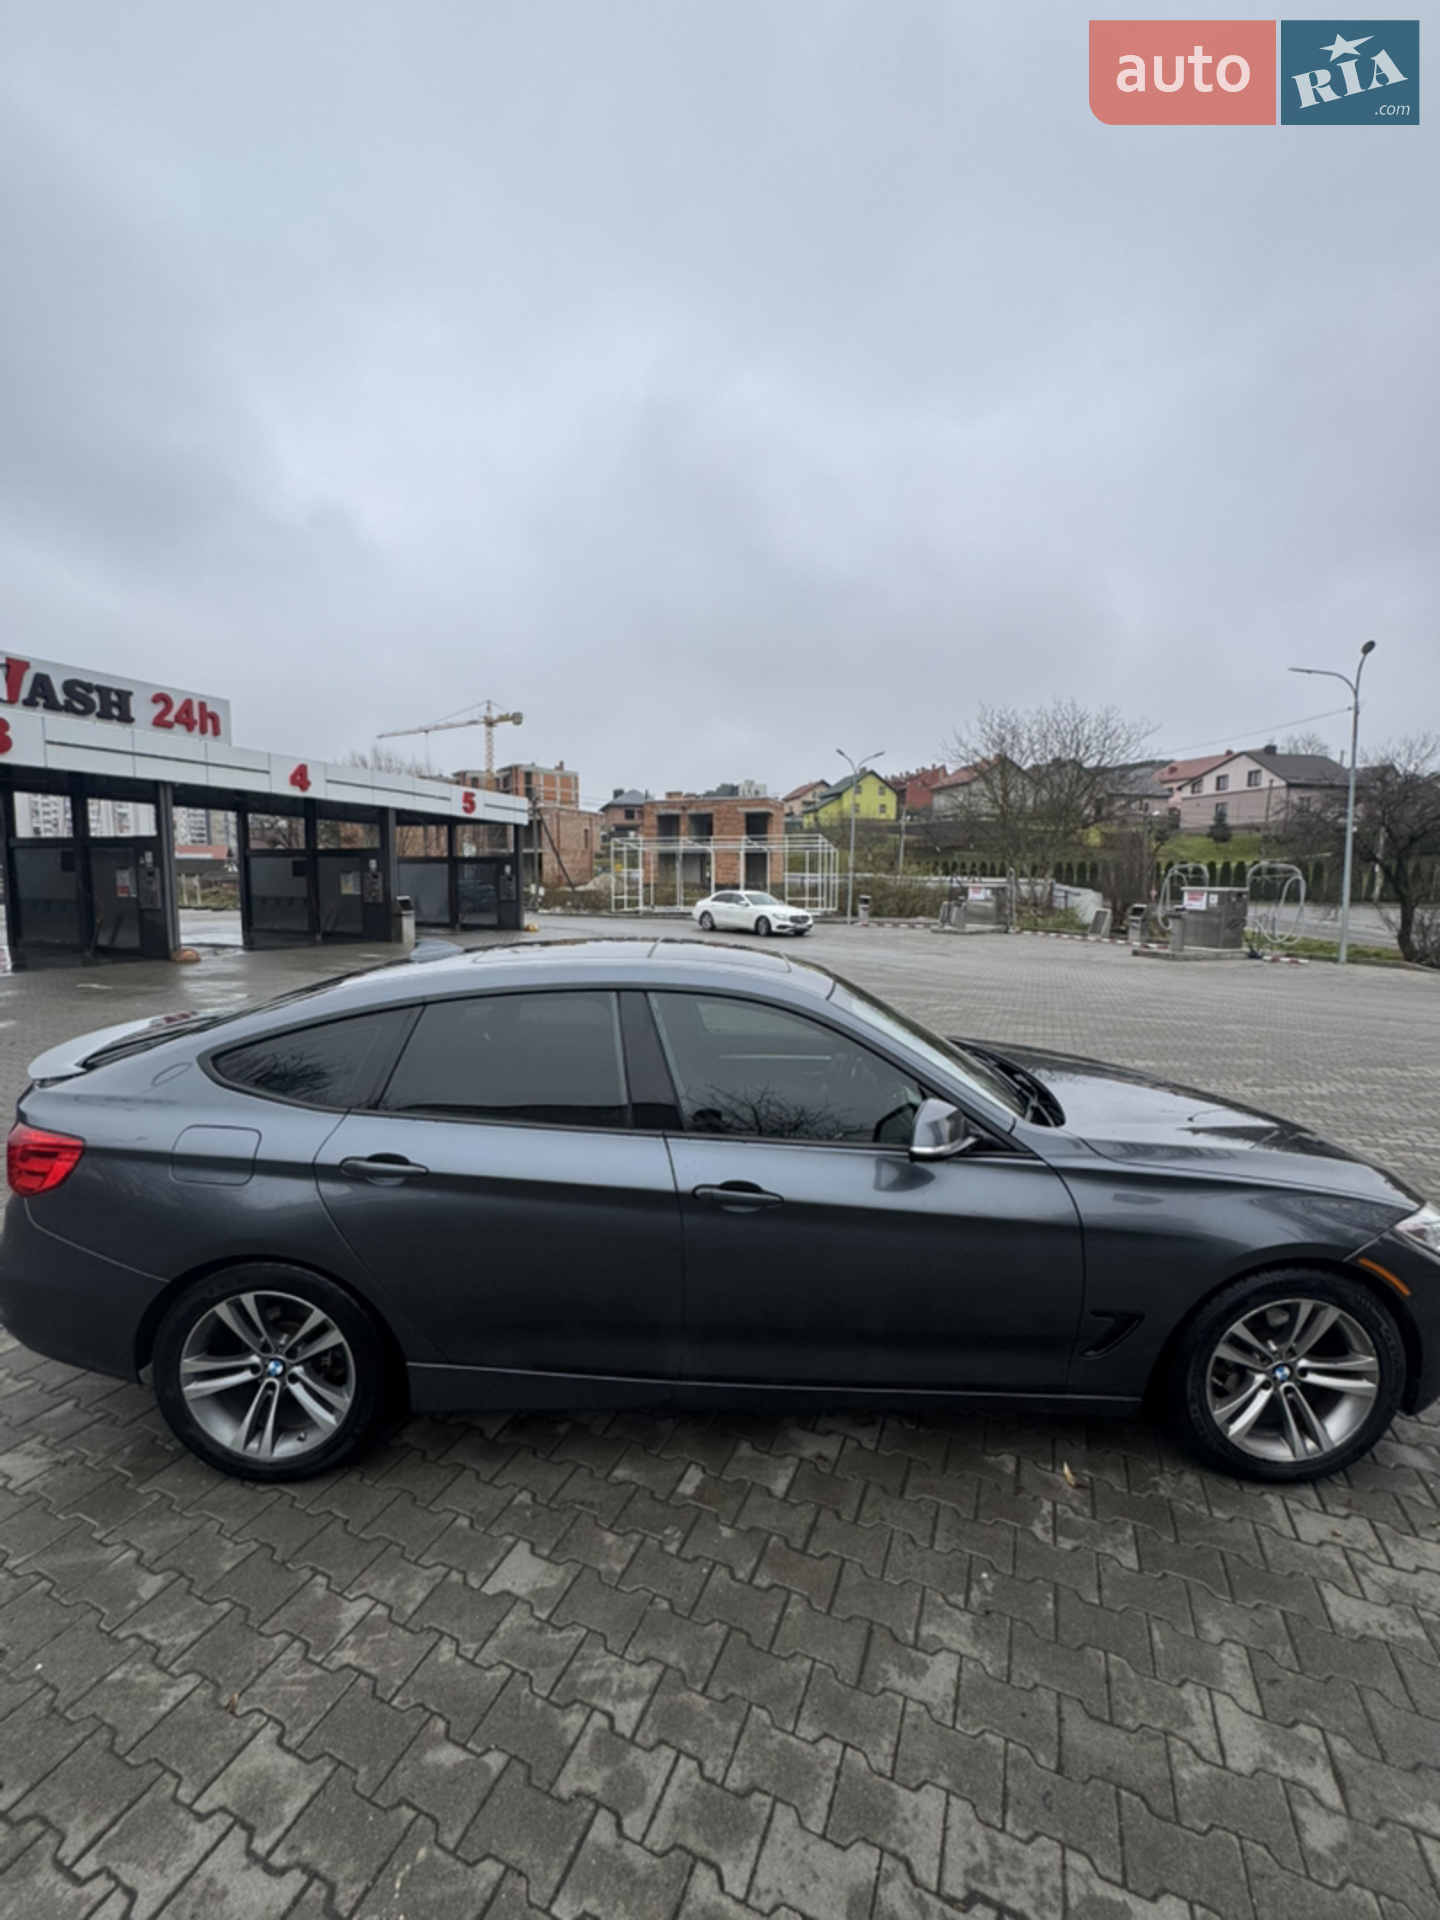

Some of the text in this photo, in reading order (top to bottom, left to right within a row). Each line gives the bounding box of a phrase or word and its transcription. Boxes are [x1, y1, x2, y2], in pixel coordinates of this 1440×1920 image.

[151, 692, 221, 737] 24h
[289, 763, 311, 793] 4
[462, 791, 476, 814] 5
